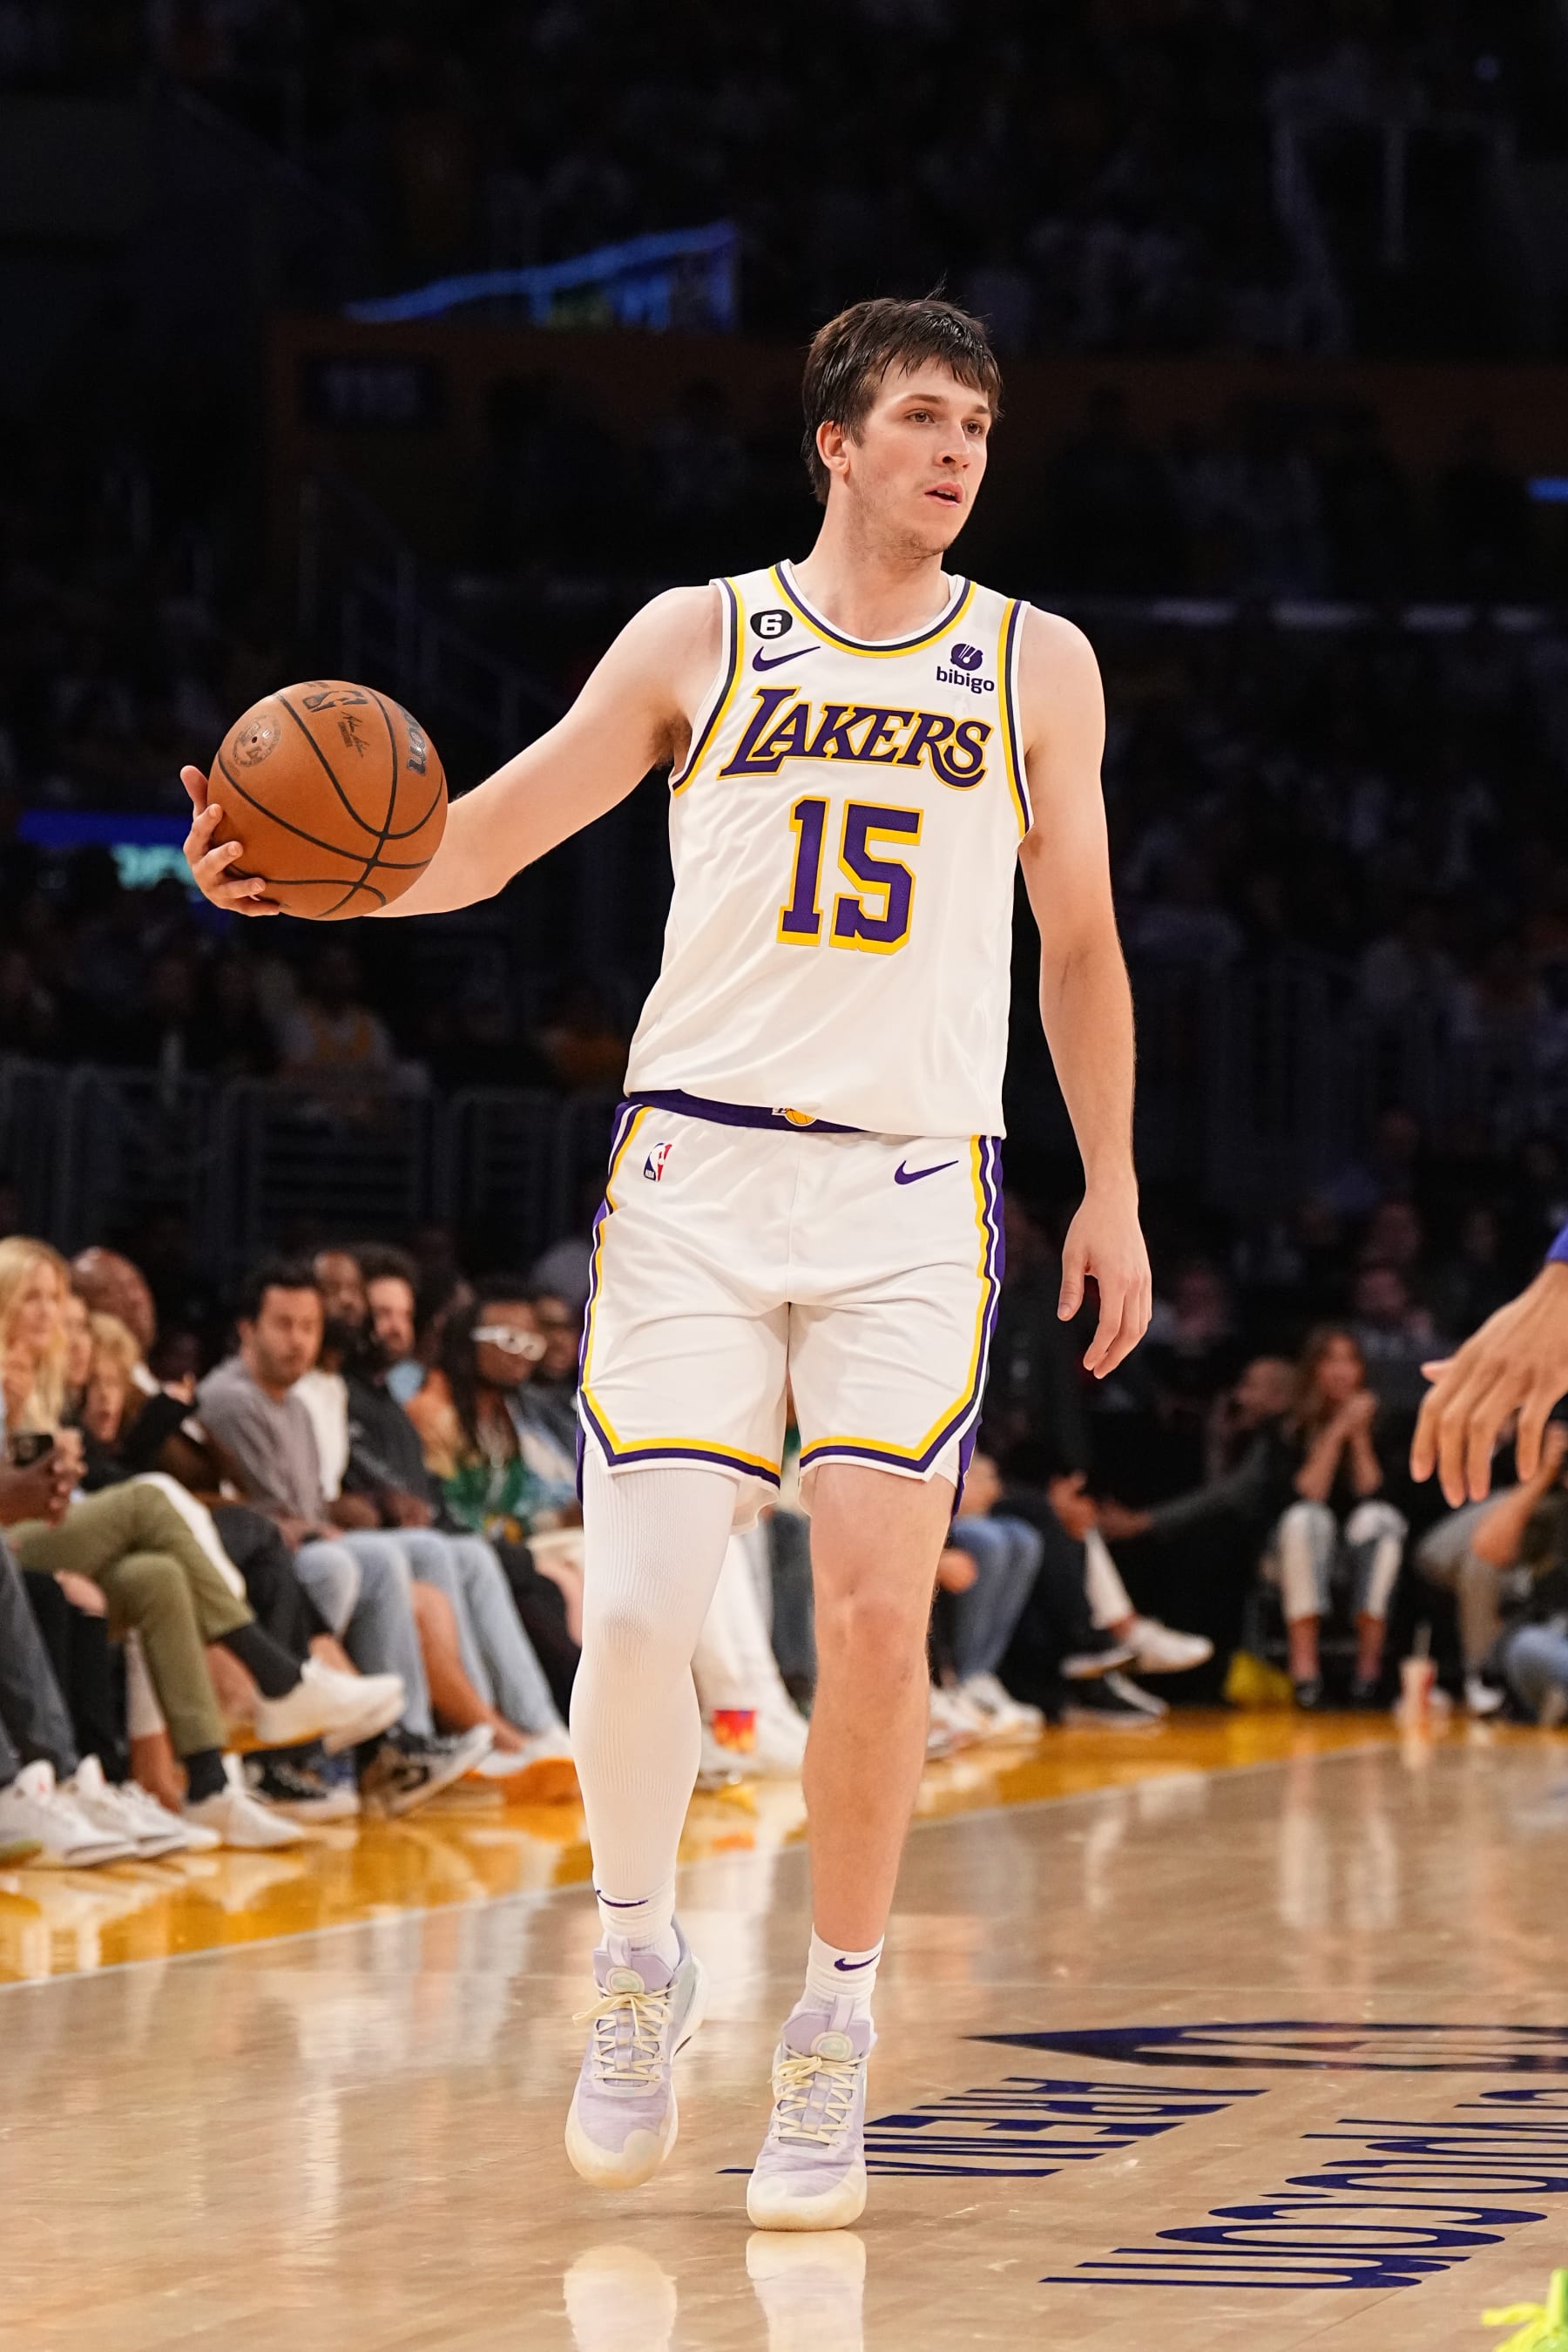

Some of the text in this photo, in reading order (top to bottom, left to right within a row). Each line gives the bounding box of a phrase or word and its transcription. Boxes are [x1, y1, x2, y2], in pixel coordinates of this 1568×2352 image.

[760, 613, 782, 636] 6
[936, 666, 995, 694] bibigo
[716, 686, 994, 790] LAKERS
[776, 795, 924, 955] 15
